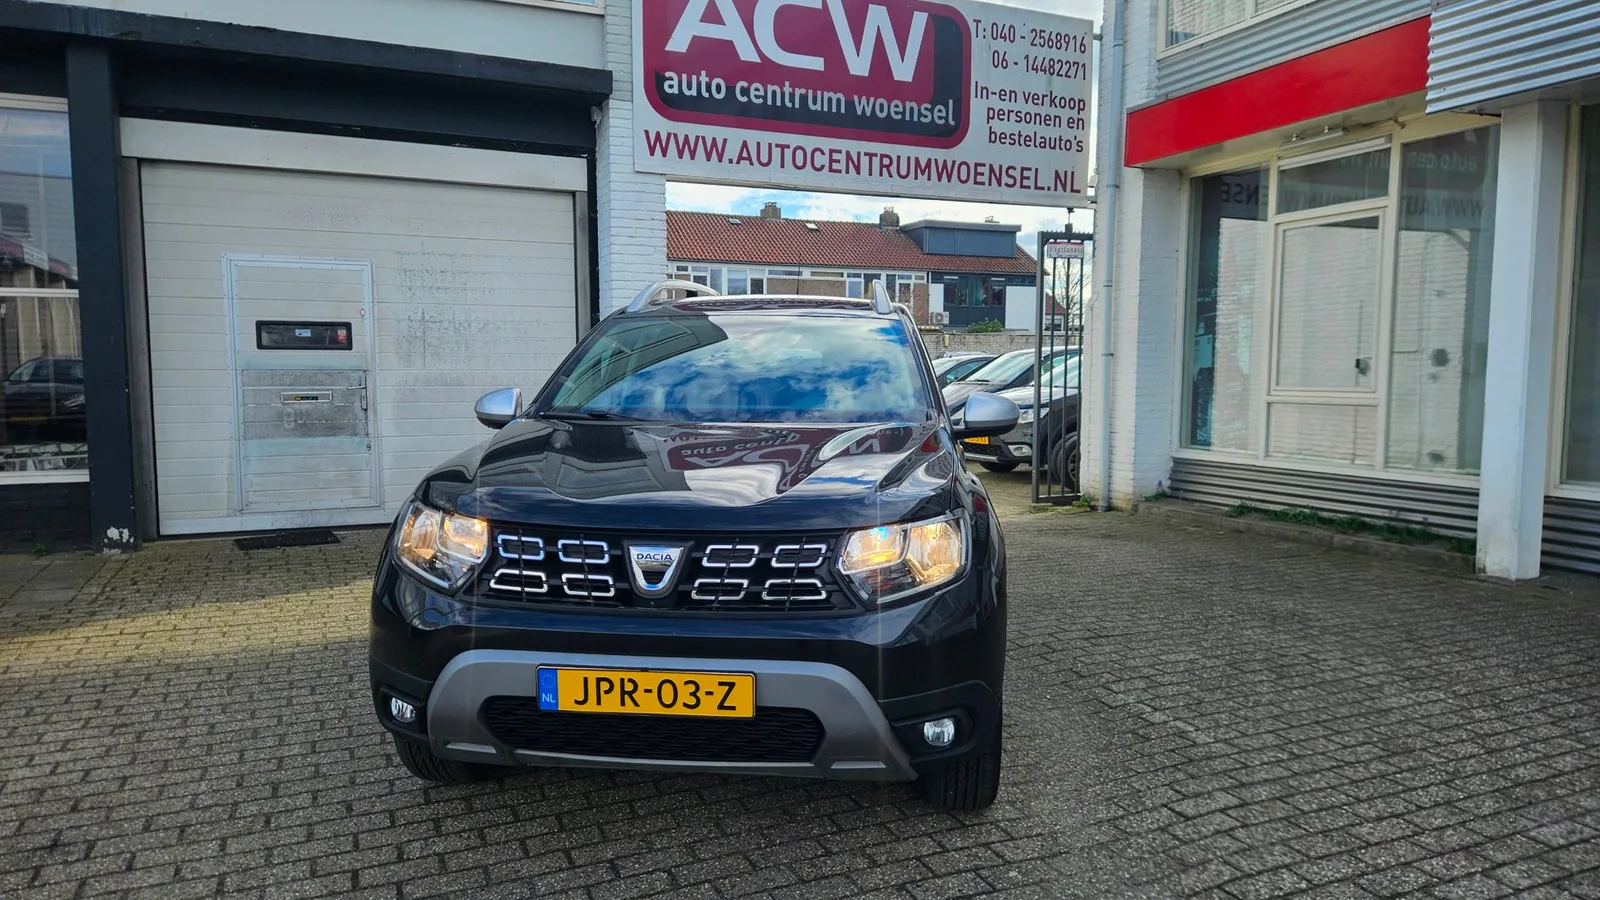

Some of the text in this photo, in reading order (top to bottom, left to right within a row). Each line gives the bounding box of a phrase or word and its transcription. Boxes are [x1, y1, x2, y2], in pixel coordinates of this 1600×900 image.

[664, 0, 929, 82] ACW
[973, 19, 986, 39] T:
[991, 22, 1015, 43] 040
[1030, 28, 1086, 54] 2568916
[992, 50, 1009, 69] 06
[1024, 54, 1086, 80] 14482271
[663, 70, 956, 126] auto centrum woensel
[974, 80, 1086, 115] In-en verkoop
[987, 106, 1085, 130] personen en
[988, 126, 1084, 152] bestelauto's
[644, 129, 1081, 194] WWW.AUTOCENTRUMWOENSEL.NL
[636, 552, 673, 561] DACIA
[541, 676, 737, 711] NL JPR-03-Z
